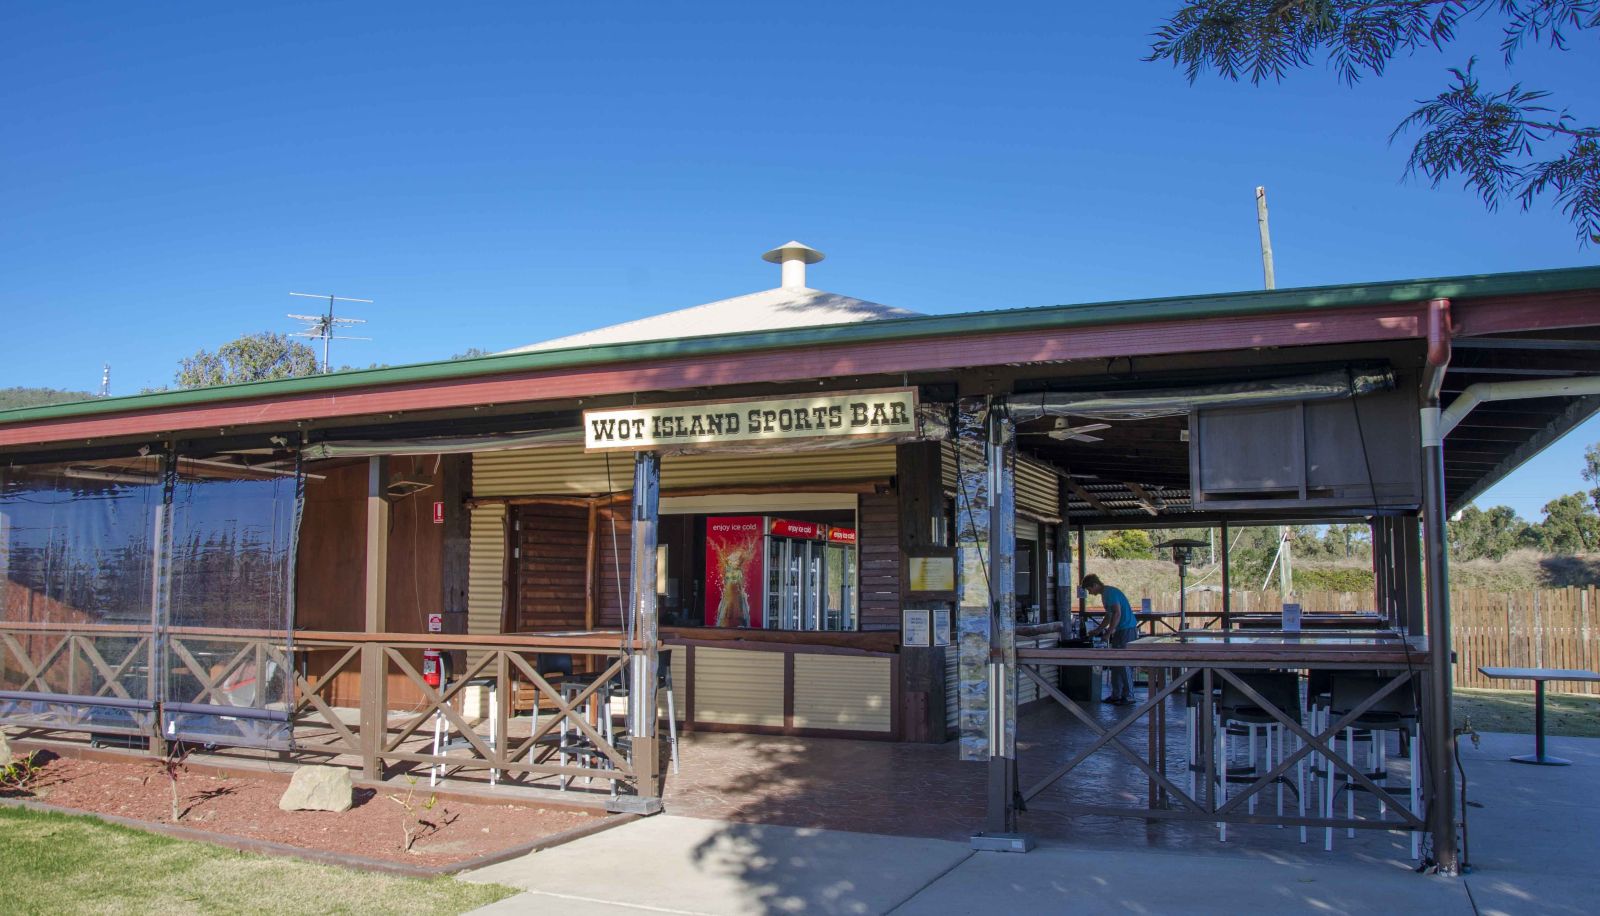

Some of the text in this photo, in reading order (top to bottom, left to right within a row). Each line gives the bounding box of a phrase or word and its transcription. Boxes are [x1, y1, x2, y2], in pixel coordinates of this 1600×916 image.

[591, 401, 909, 441] WOT ISLAND SPORTS BAR
[712, 523, 757, 532] enjoy ice cold
